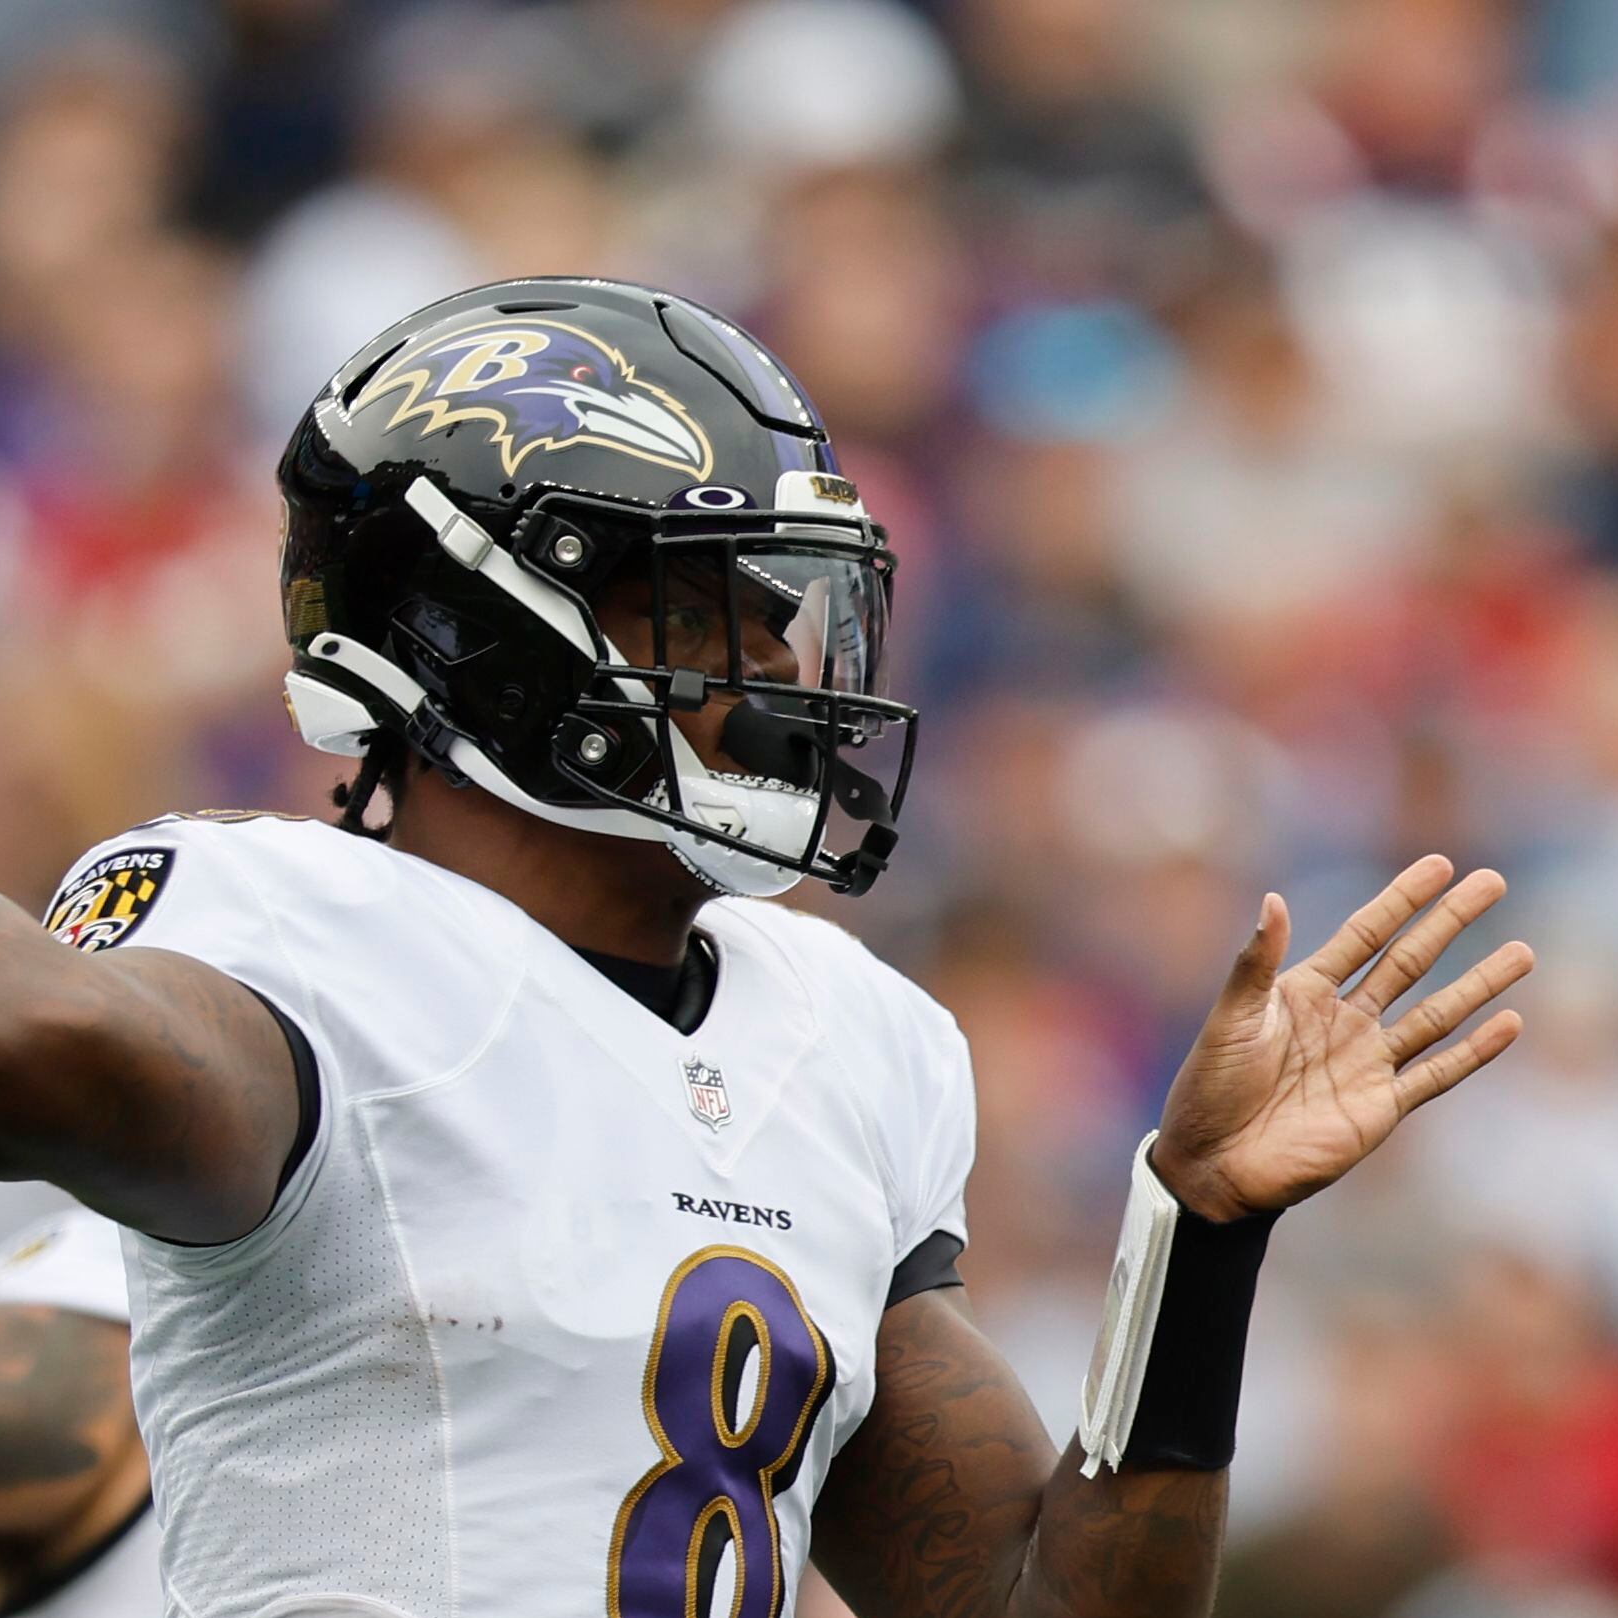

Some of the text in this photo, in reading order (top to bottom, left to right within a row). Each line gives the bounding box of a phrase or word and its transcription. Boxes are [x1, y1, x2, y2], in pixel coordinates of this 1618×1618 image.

[428, 330, 550, 396] B
[64, 853, 166, 897] RAVENS
[692, 1086, 728, 1117] NFL
[671, 1192, 793, 1231] RAVENS
